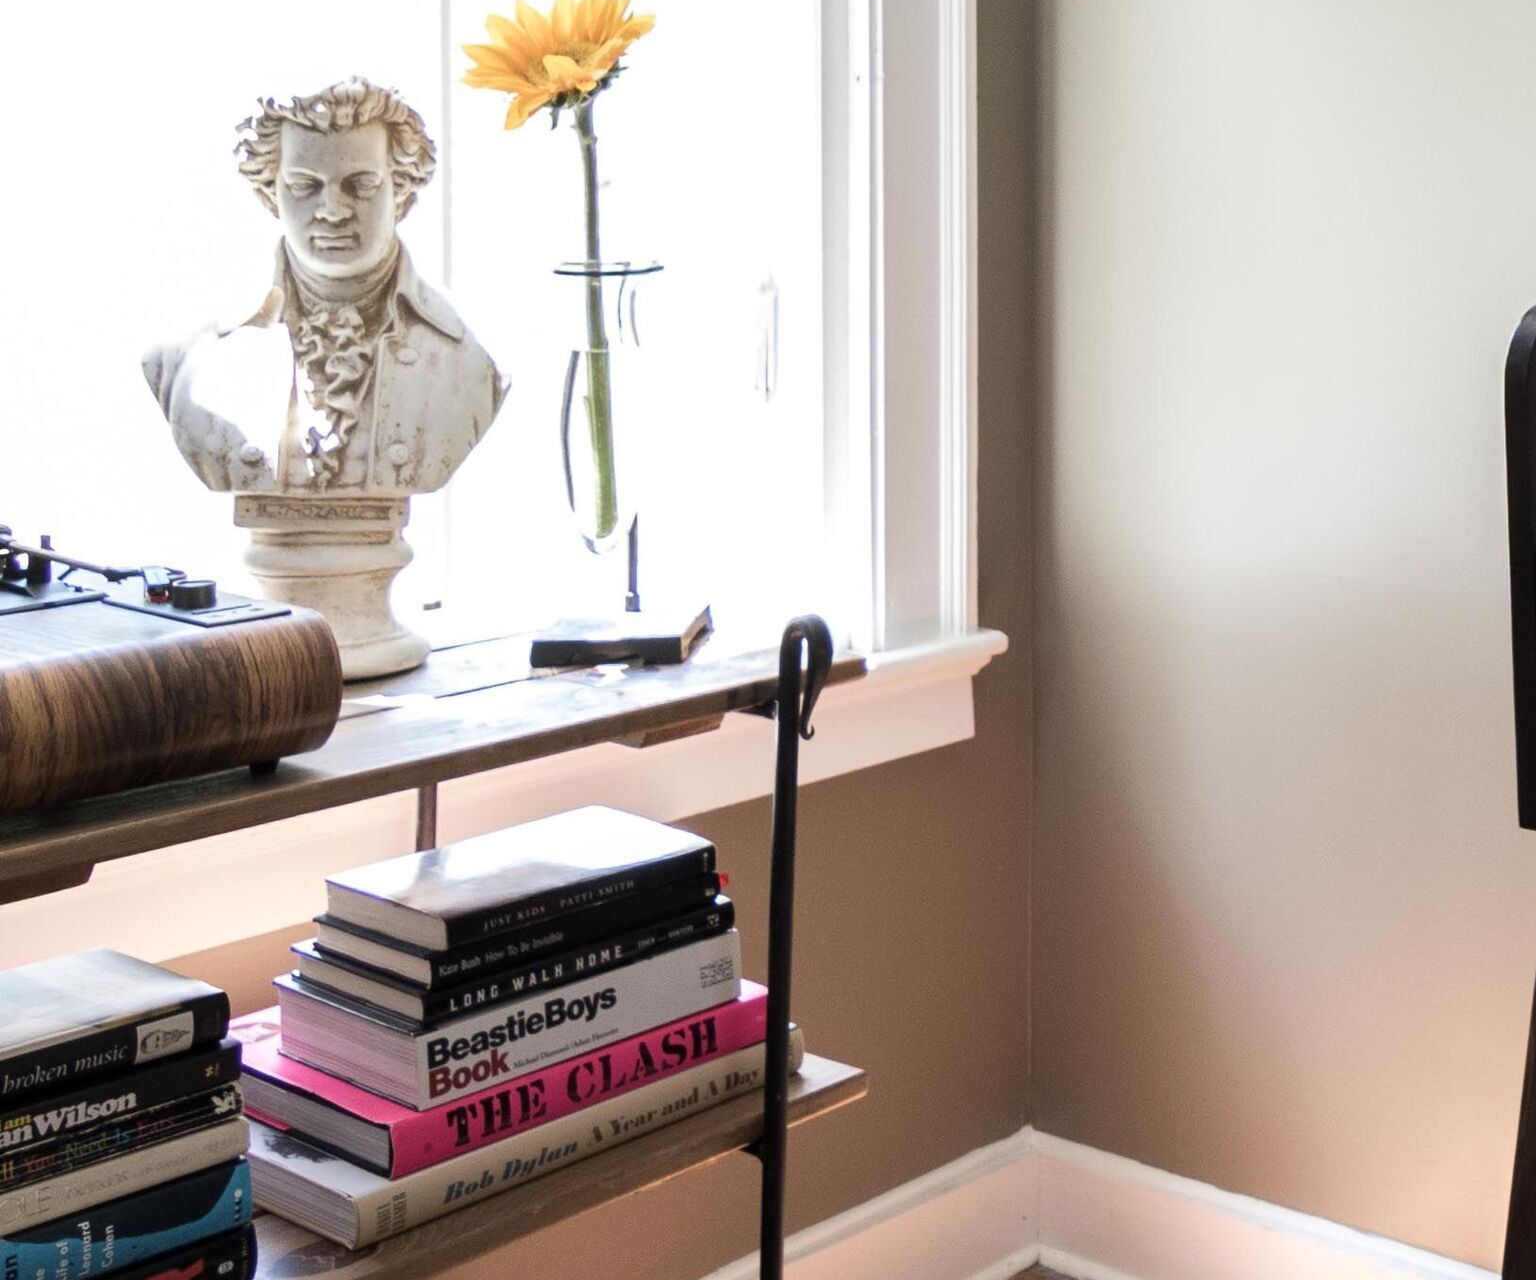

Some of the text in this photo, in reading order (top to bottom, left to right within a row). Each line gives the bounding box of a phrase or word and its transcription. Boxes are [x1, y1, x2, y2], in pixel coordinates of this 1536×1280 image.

[483, 880, 635, 931] JUST KIDS PATTI SMITH
[449, 984, 500, 1012] LONG
[575, 944, 624, 971] HOME
[1, 1044, 129, 1094] broken music
[428, 1049, 511, 1100] Book
[446, 1015, 719, 1147] THE CLASH
[443, 1067, 760, 1204] Bob Dylan A Year and A Day
[56, 1239, 69, 1256] of
[77, 1220, 91, 1276] Leonard
[101, 1224, 115, 1269] Cohen
